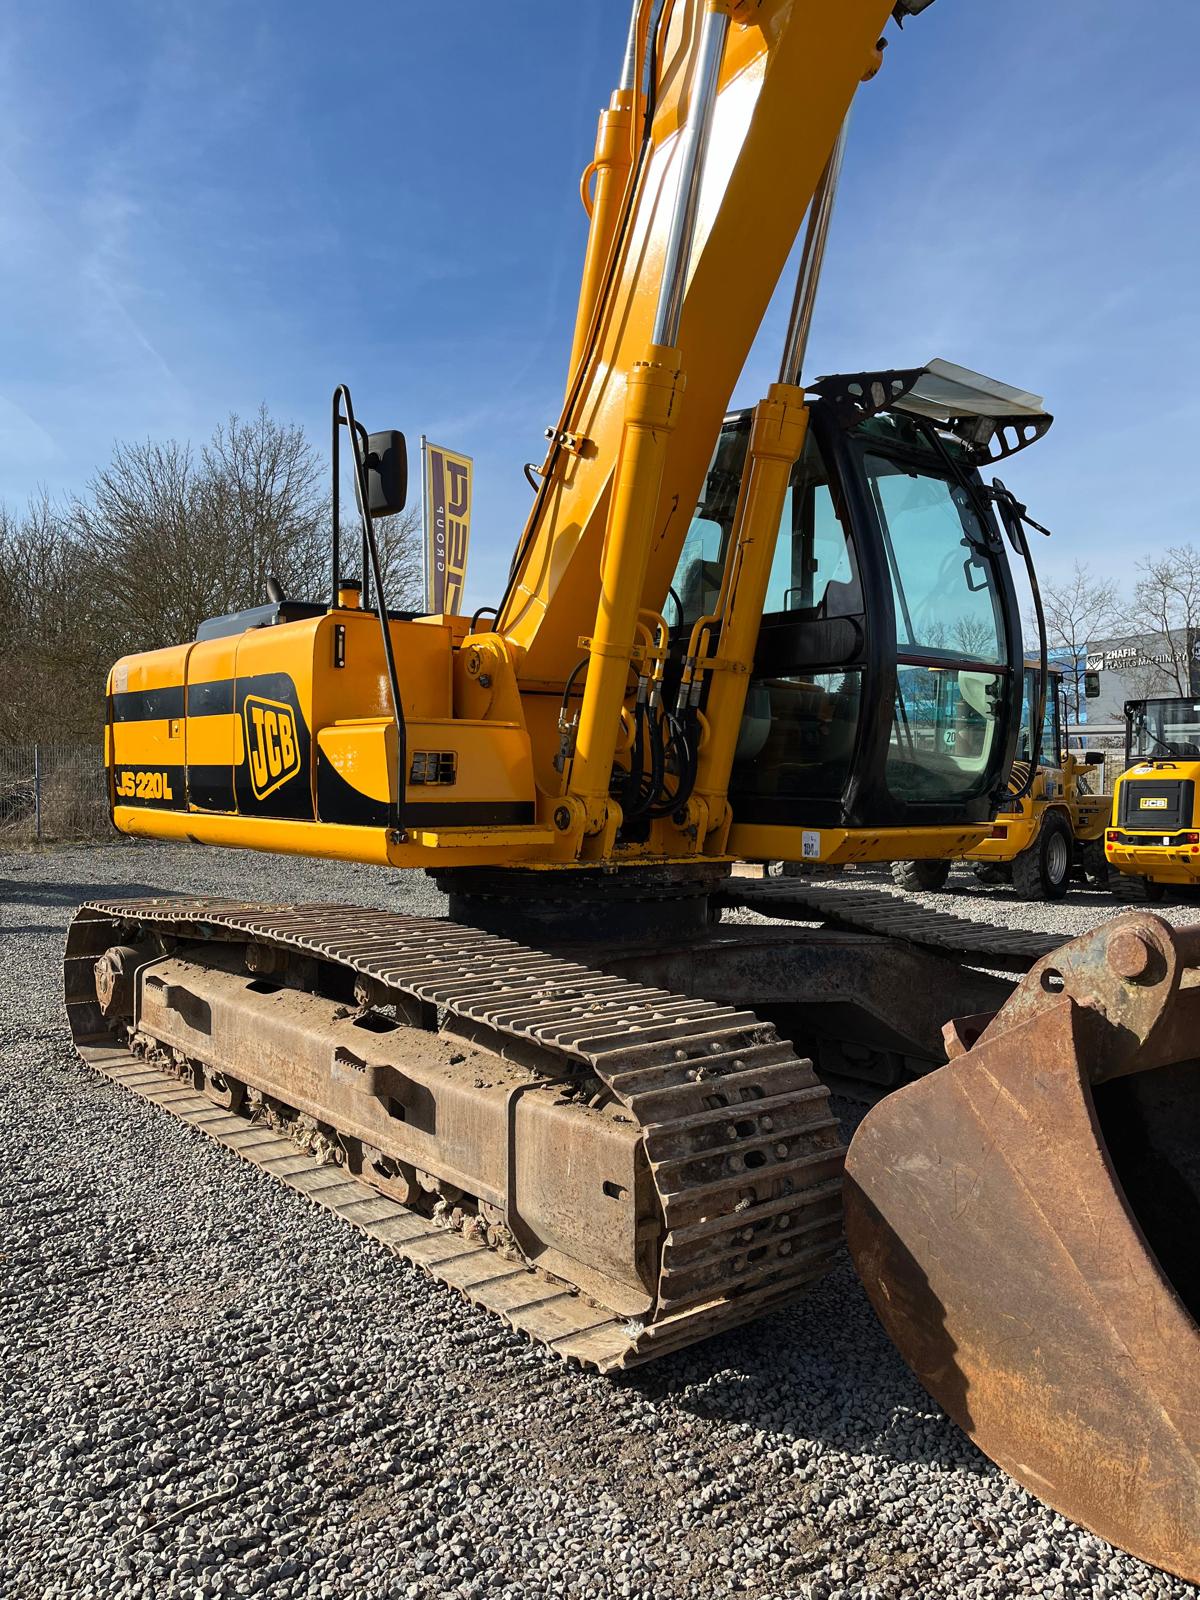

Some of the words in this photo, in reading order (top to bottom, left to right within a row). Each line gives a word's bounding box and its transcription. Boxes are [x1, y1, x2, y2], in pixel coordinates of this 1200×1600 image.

[251, 706, 295, 788] JCB
[946, 731, 956, 743] 20
[116, 771, 173, 800] JS220L
[1142, 799, 1166, 807] JCB
